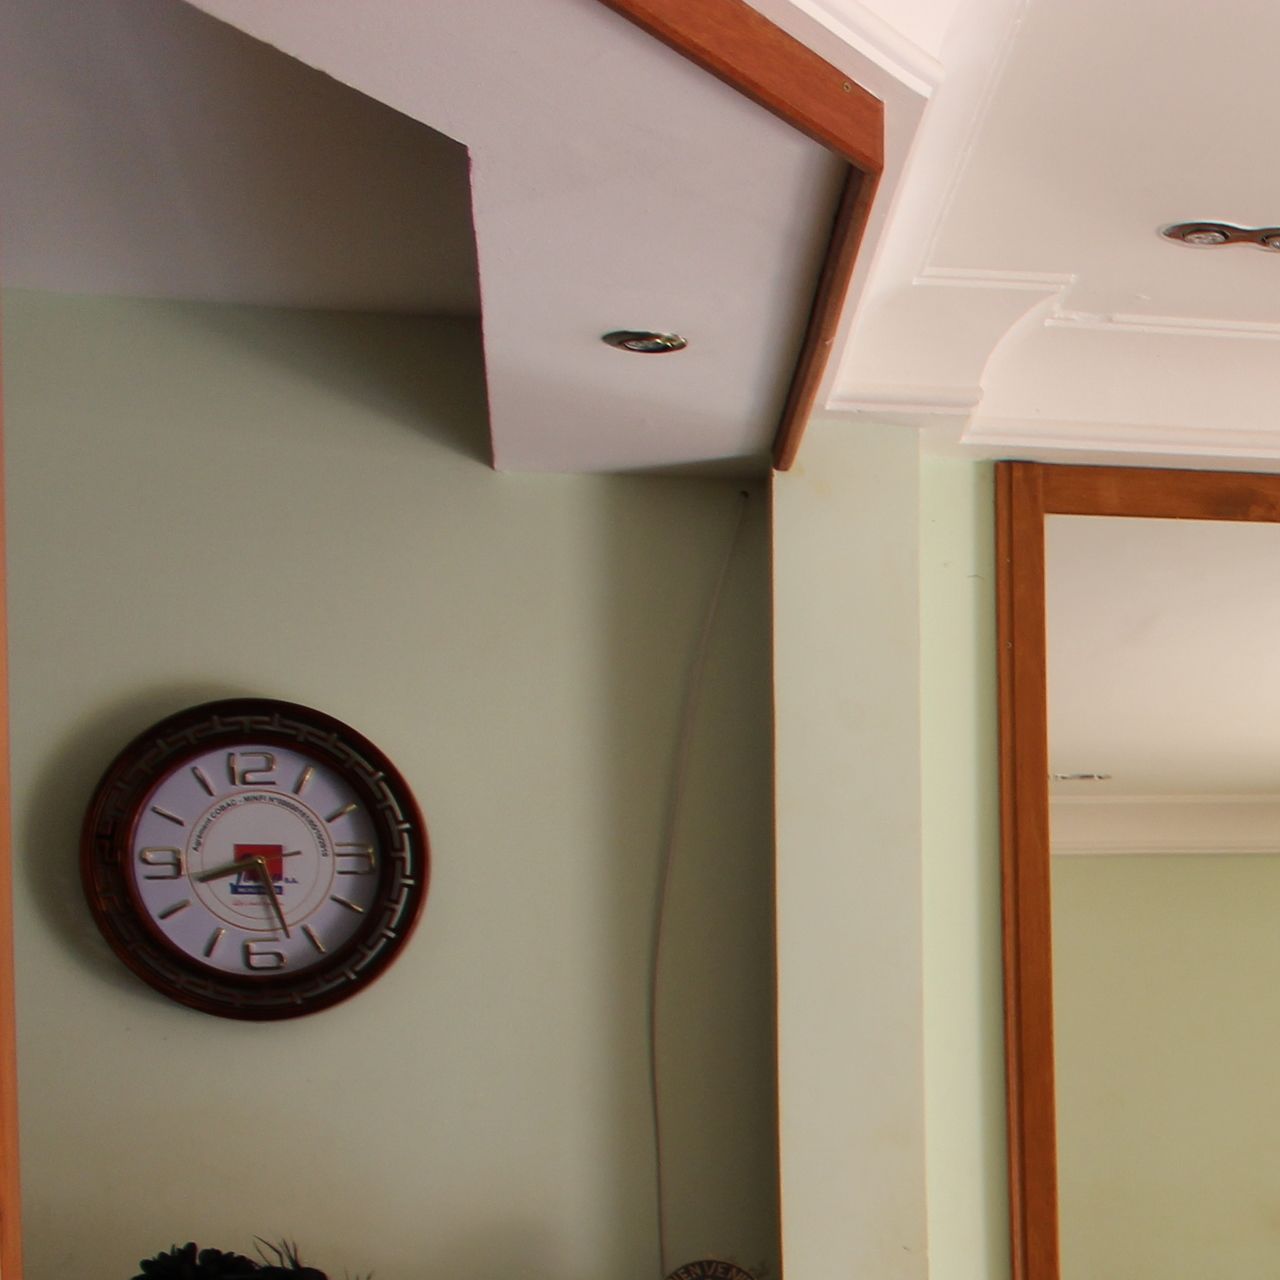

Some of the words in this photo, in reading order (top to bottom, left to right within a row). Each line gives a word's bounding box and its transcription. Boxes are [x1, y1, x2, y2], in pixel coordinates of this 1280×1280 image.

[226, 750, 278, 787] 12
[141, 847, 184, 881] 9
[243, 937, 287, 972] 6
